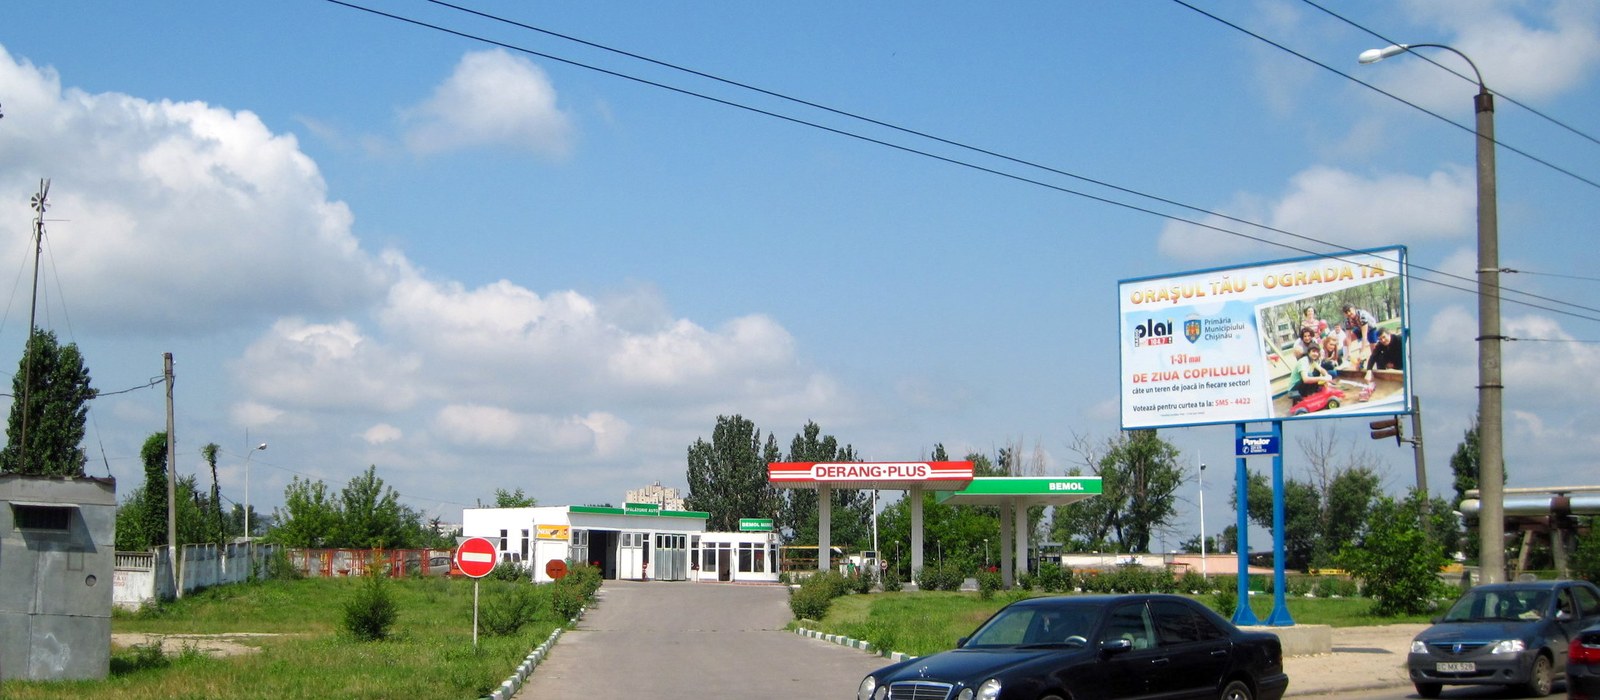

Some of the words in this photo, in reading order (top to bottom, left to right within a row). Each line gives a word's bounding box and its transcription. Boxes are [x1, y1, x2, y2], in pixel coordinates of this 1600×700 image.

[1209, 275, 1247, 295] TĂU
[1263, 265, 1353, 289] OGRADA
[1358, 262, 1385, 278] TA
[1204, 317, 1231, 325] Primăria
[1204, 323, 1244, 333] Municipiului
[1171, 354, 1187, 364] 1-31
[1133, 373, 1148, 383] DE
[1151, 371, 1180, 382] ZIUA
[1183, 364, 1251, 379] COPILULUI
[1132, 386, 1145, 394] câte
[1154, 384, 1171, 392] teren
[1171, 383, 1180, 391] de
[1180, 382, 1198, 392] joacă
[1206, 380, 1227, 388] fiecare
[1228, 379, 1251, 387] sector!
[1133, 404, 1156, 412] Votează
[1157, 403, 1177, 411] pentru
[1178, 401, 1198, 409] curtea
[1215, 398, 1229, 406] SMS
[1049, 482, 1084, 490] BEMOL
